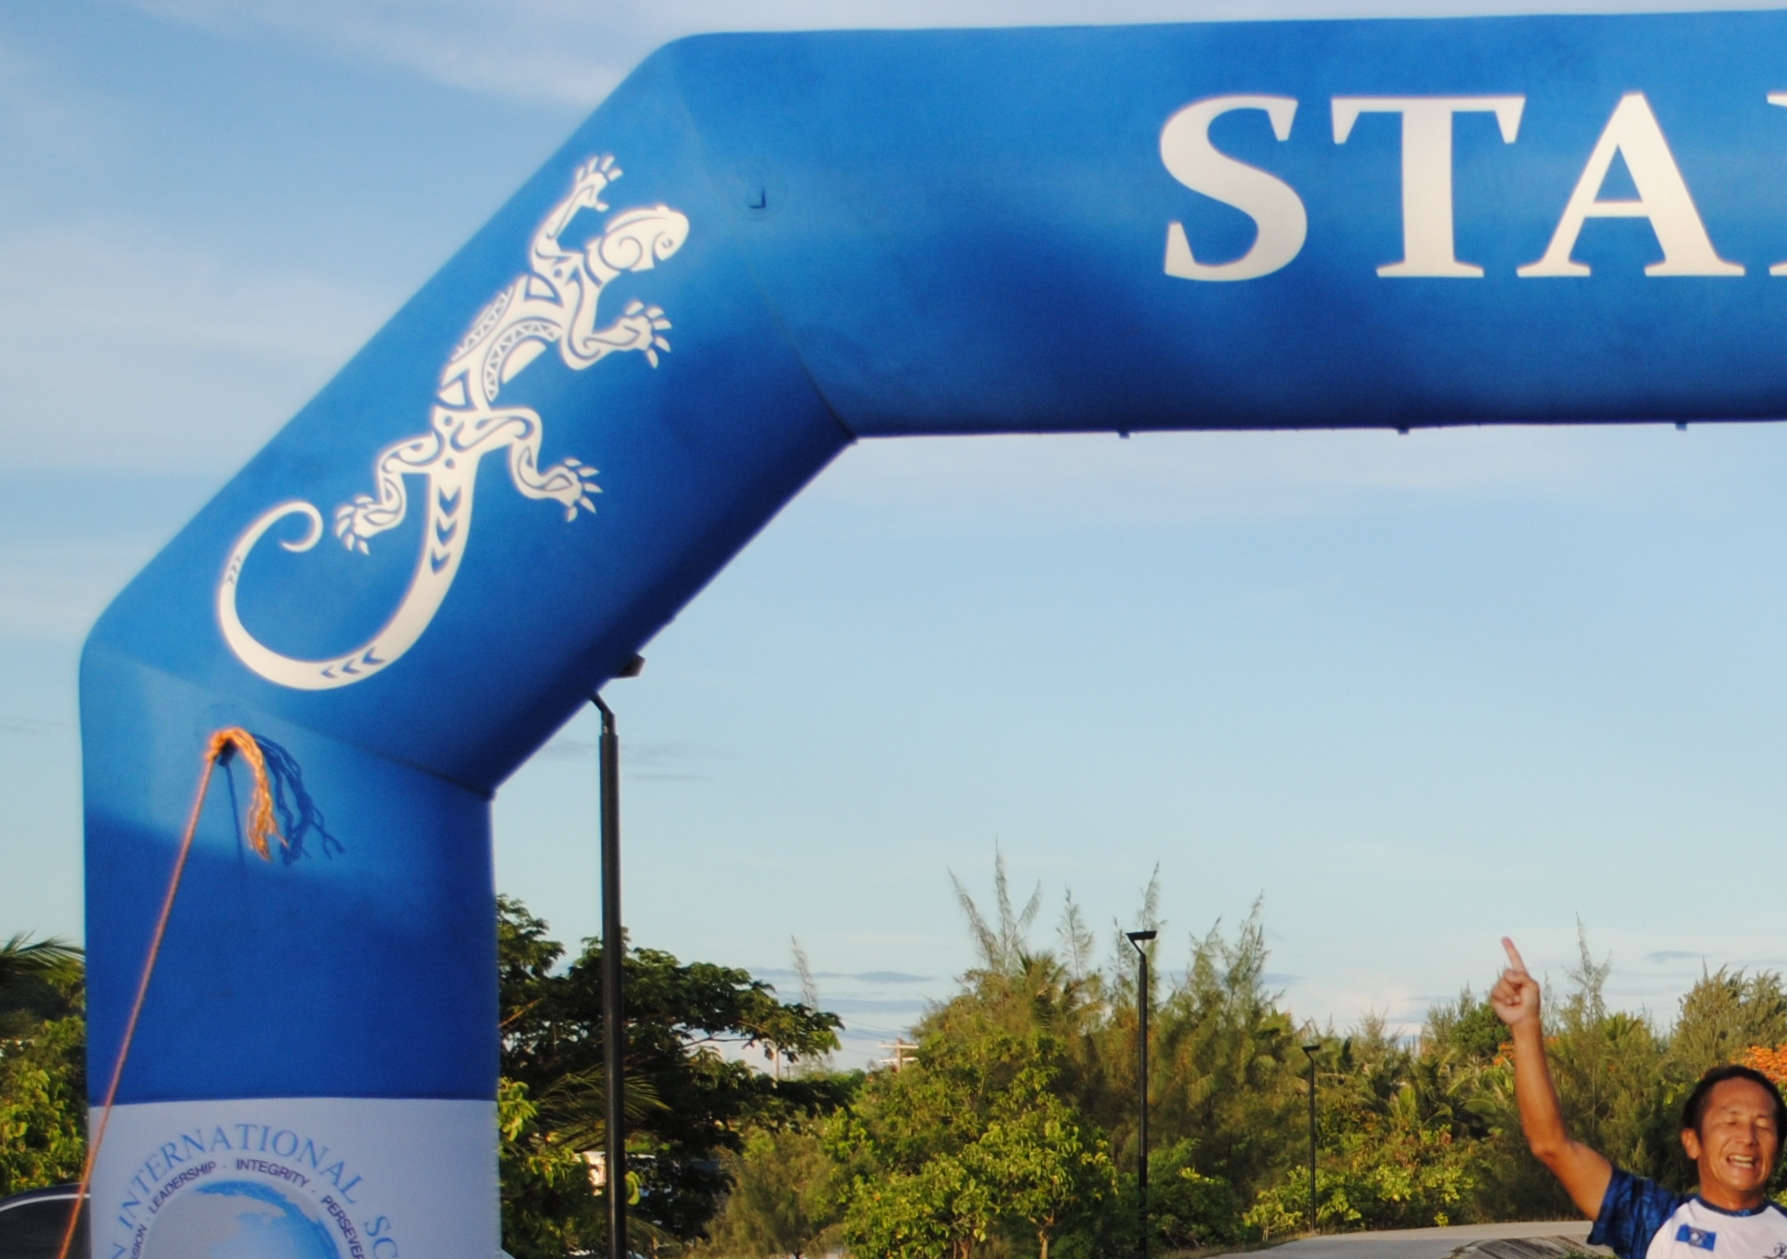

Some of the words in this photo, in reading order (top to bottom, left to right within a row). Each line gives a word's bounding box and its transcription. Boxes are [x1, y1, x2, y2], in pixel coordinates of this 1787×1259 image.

[119, 1123, 365, 1230] INTERNATIONAL
[148, 1160, 217, 1214] LEADERSHIP
[236, 1158, 310, 1189] INTEGRITY
